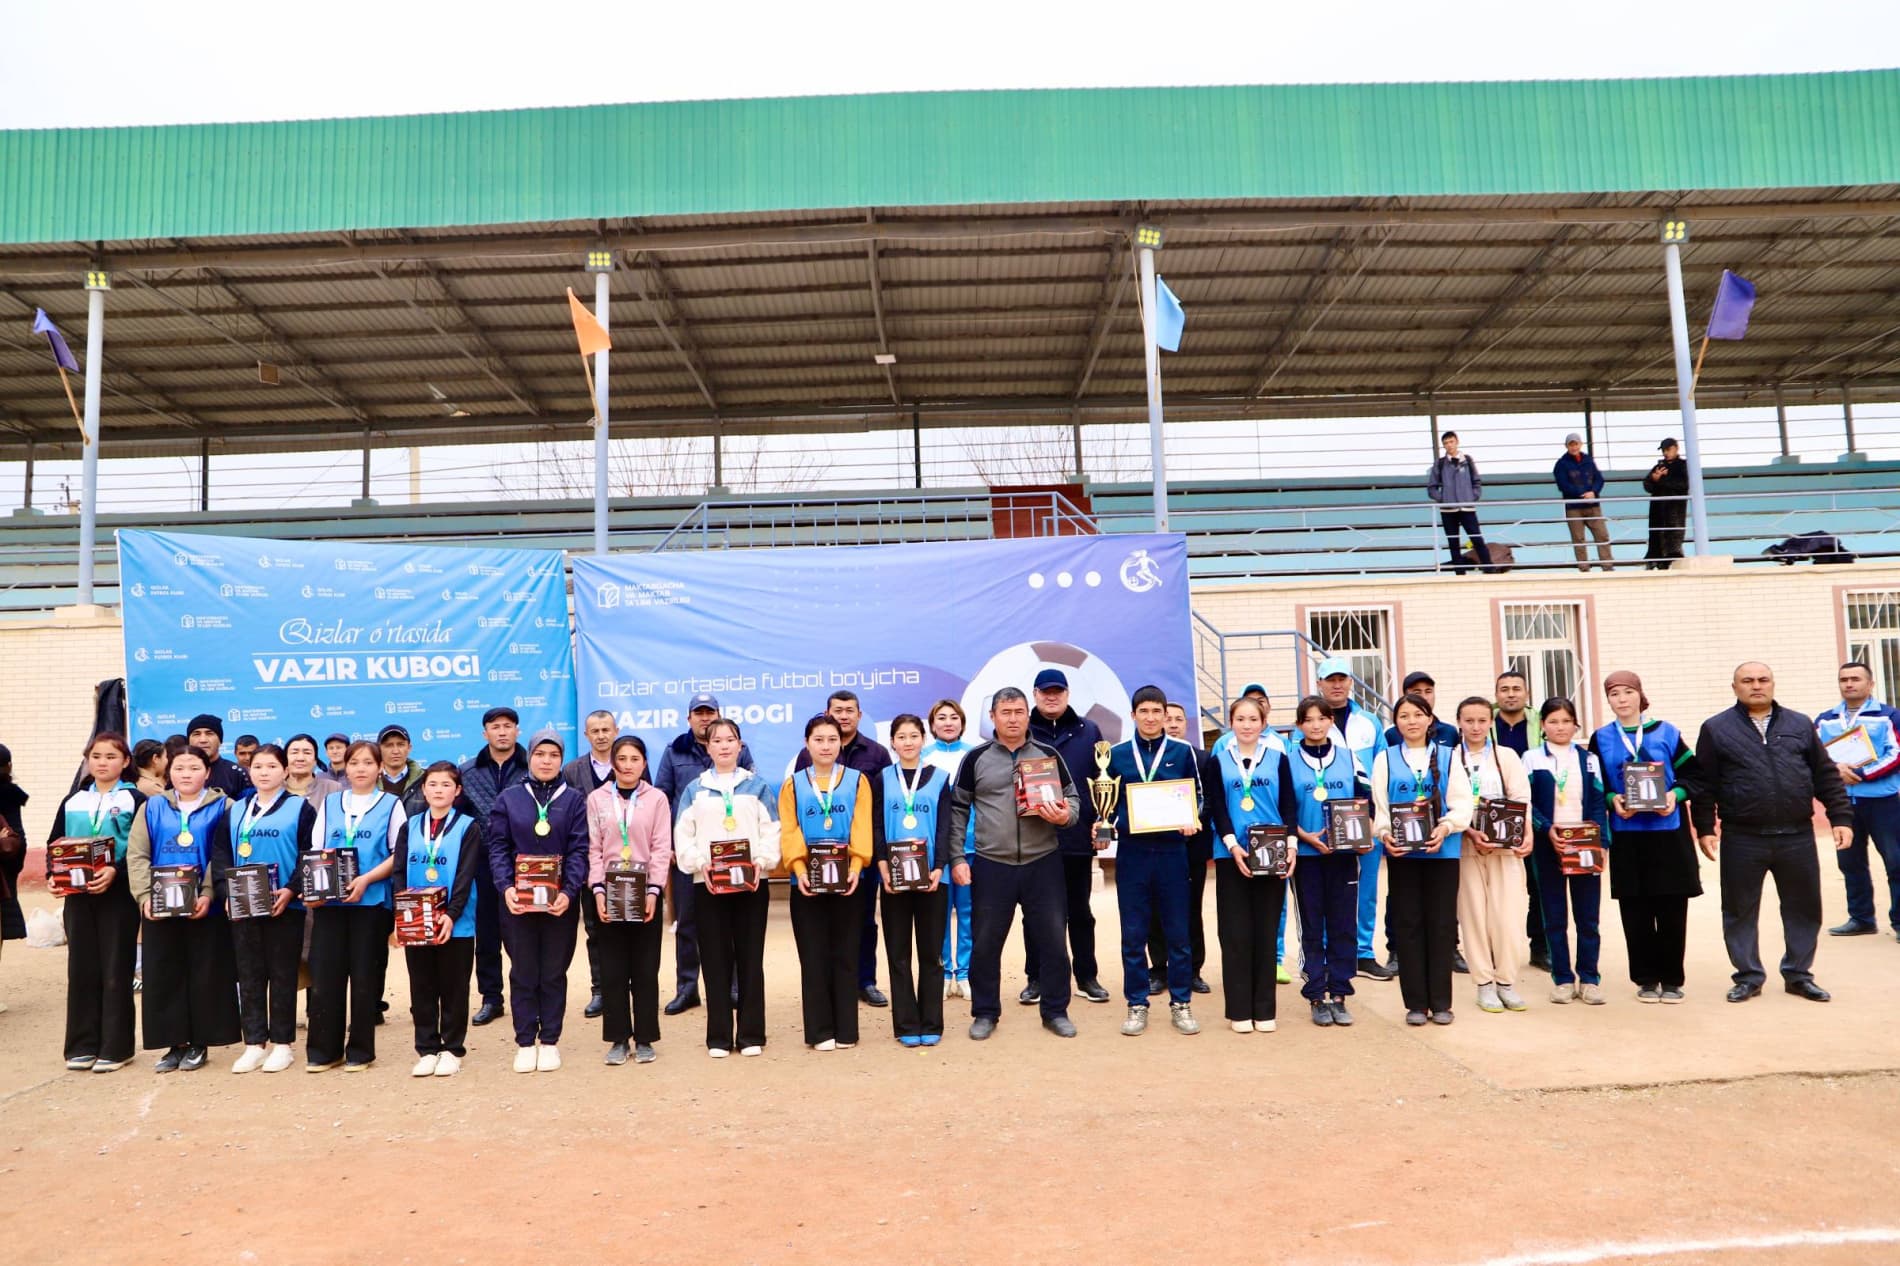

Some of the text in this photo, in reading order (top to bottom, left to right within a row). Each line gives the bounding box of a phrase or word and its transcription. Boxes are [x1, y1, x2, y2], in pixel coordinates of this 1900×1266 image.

[279, 618, 453, 645] Qizlar o'rtasida
[253, 655, 480, 683] VAZIR KUBOGI
[598, 667, 920, 697] Qizlar o'rtasida futbol bo'yicha
[687, 703, 793, 725] BOGI
[250, 828, 280, 838] JAKO
